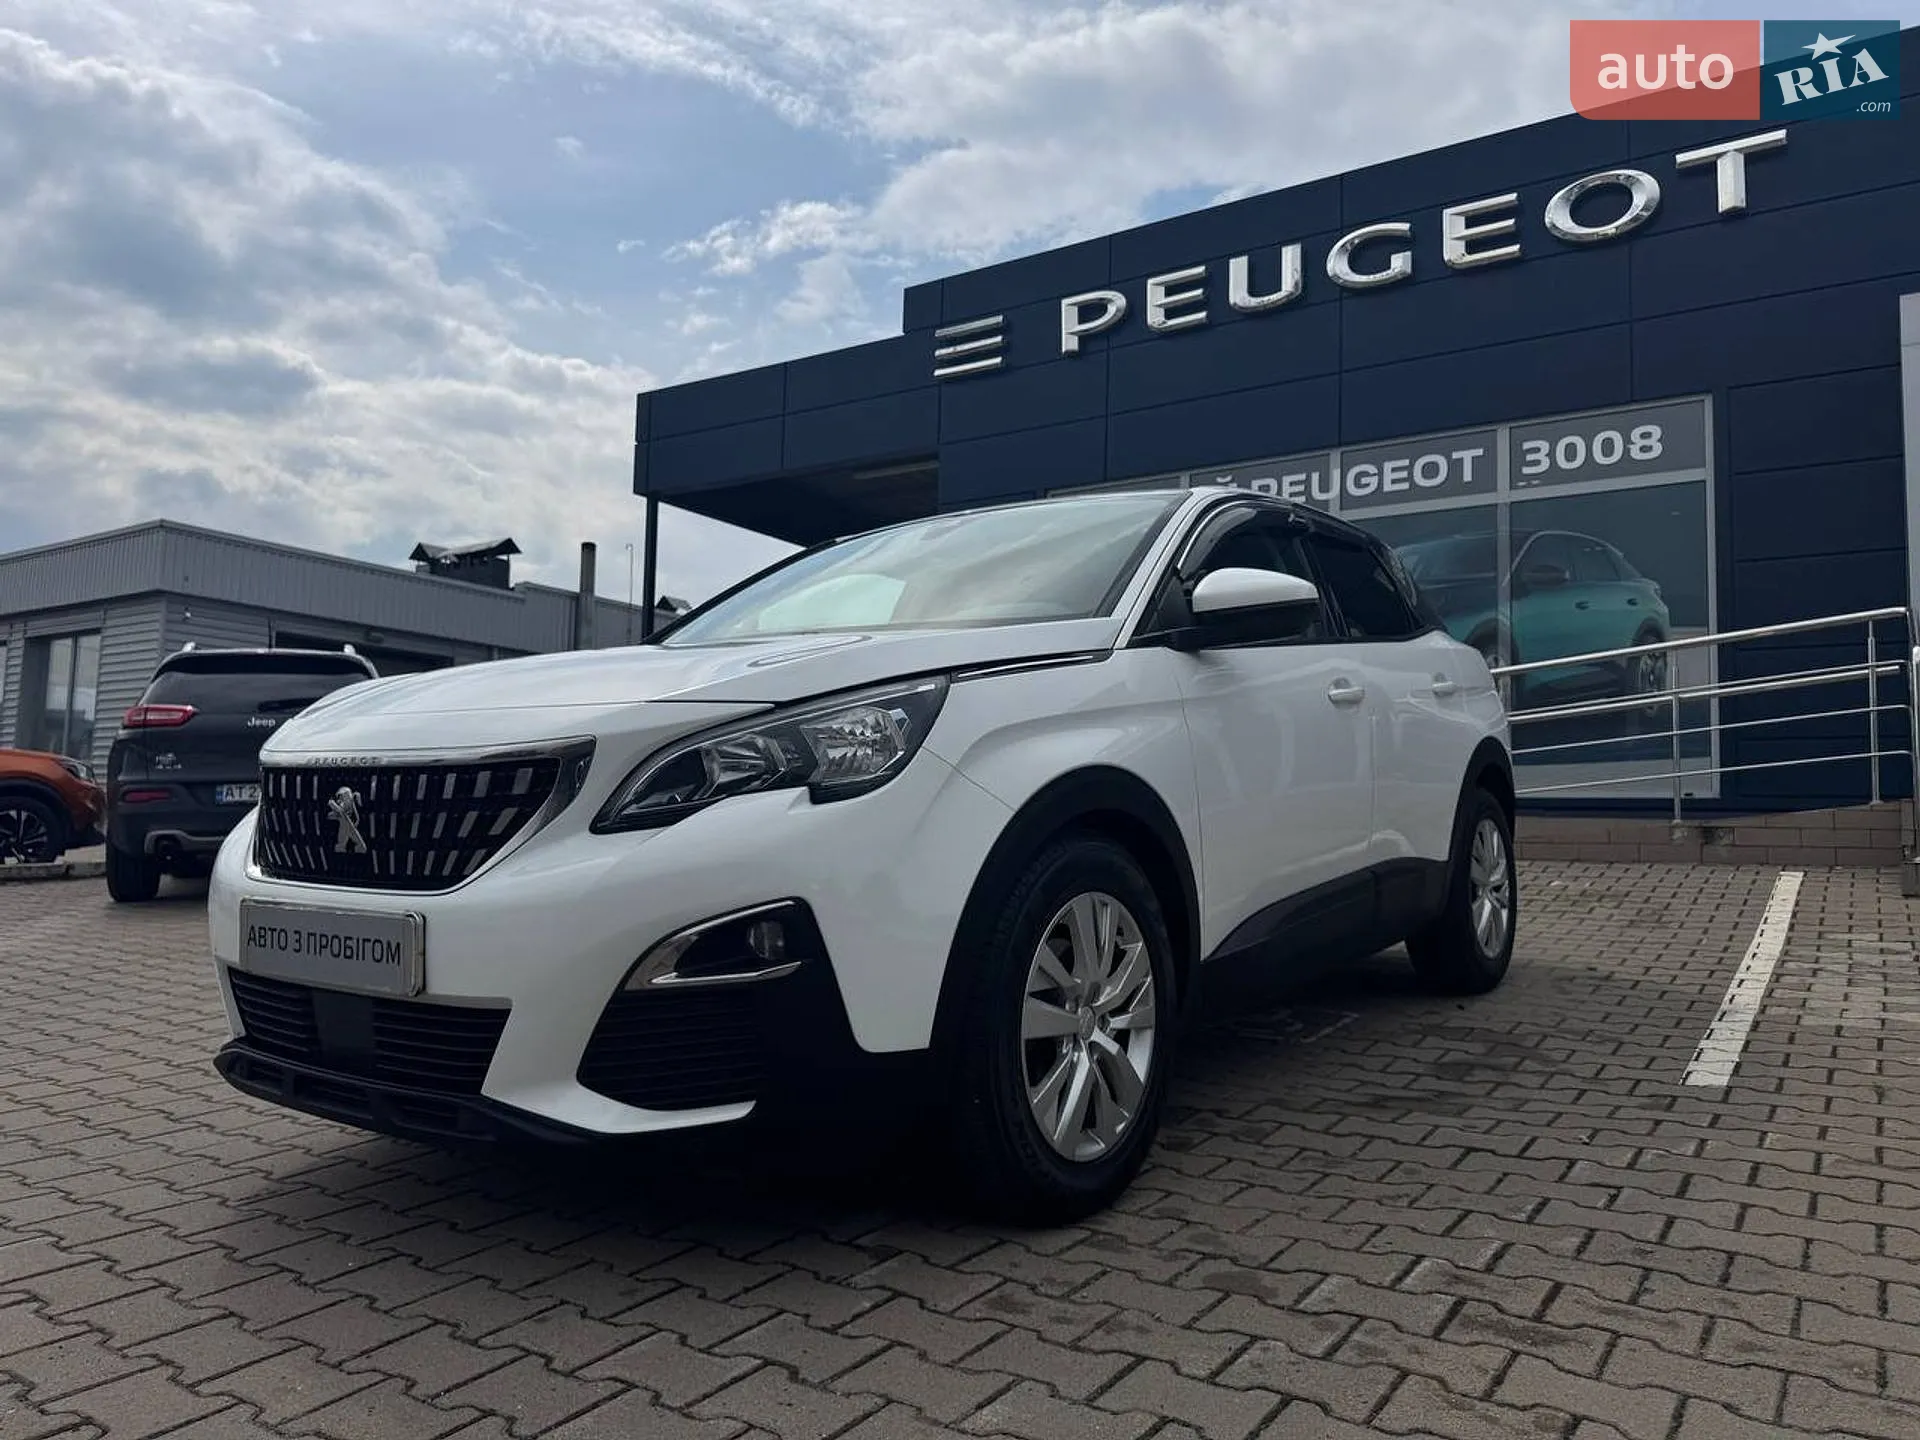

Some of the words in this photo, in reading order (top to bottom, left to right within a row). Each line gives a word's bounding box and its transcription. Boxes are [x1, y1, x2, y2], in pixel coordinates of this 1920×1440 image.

[1061, 129, 1788, 355] PEUGEOT
[1251, 448, 1484, 503] PEUGEOT
[1522, 425, 1664, 475] 3008
[247, 716, 276, 728] Jeep
[248, 924, 288, 951] АВТО
[307, 932, 401, 966] ПРОБІГОМ
